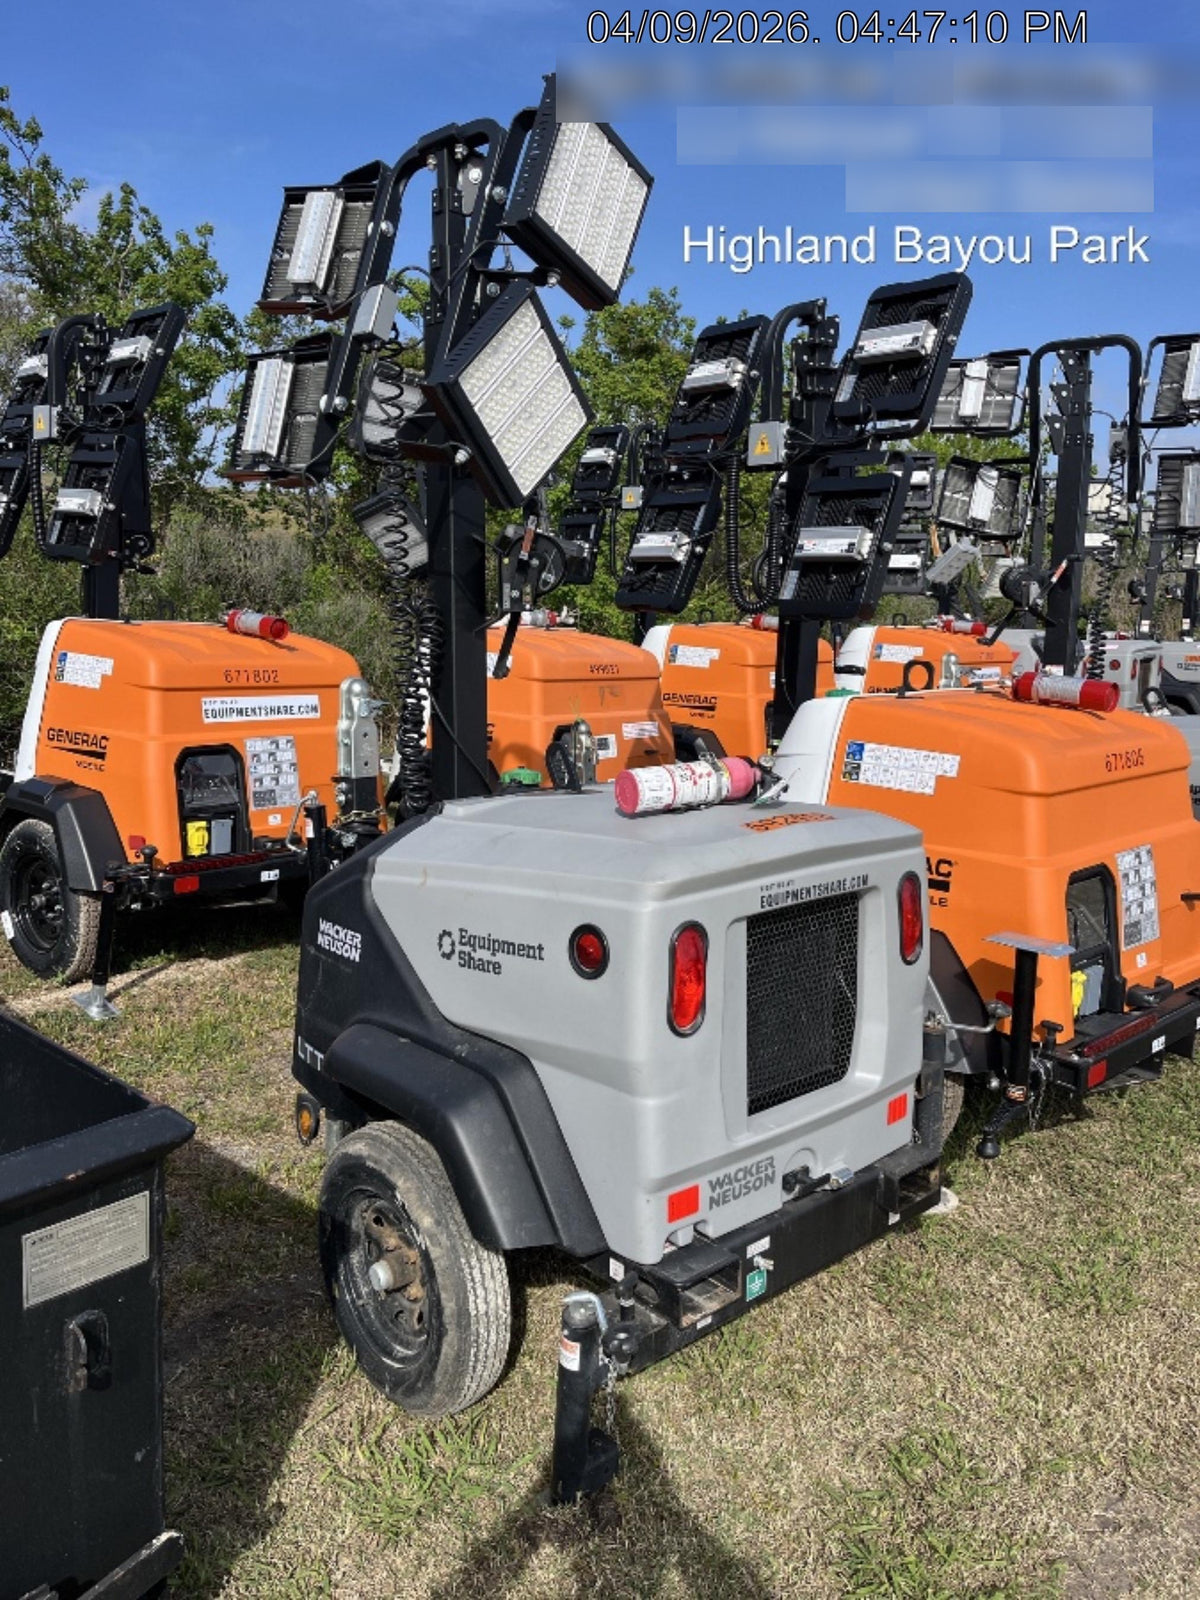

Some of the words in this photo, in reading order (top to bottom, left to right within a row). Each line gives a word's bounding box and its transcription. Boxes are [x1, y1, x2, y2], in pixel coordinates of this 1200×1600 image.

[203, 704, 319, 719] EQUIPMENTSHARE.COM
[47, 727, 110, 750] GENERAC
[760, 874, 869, 909] EQUIPMENTSHARE.COM
[317, 932, 362, 963] NEUSON
[319, 917, 362, 948] WACKER
[458, 928, 545, 961] Equipment
[458, 952, 502, 975] Share
[298, 1036, 324, 1071] LTT
[708, 1155, 775, 1192] WACKER
[708, 1171, 776, 1211] NEUSON
